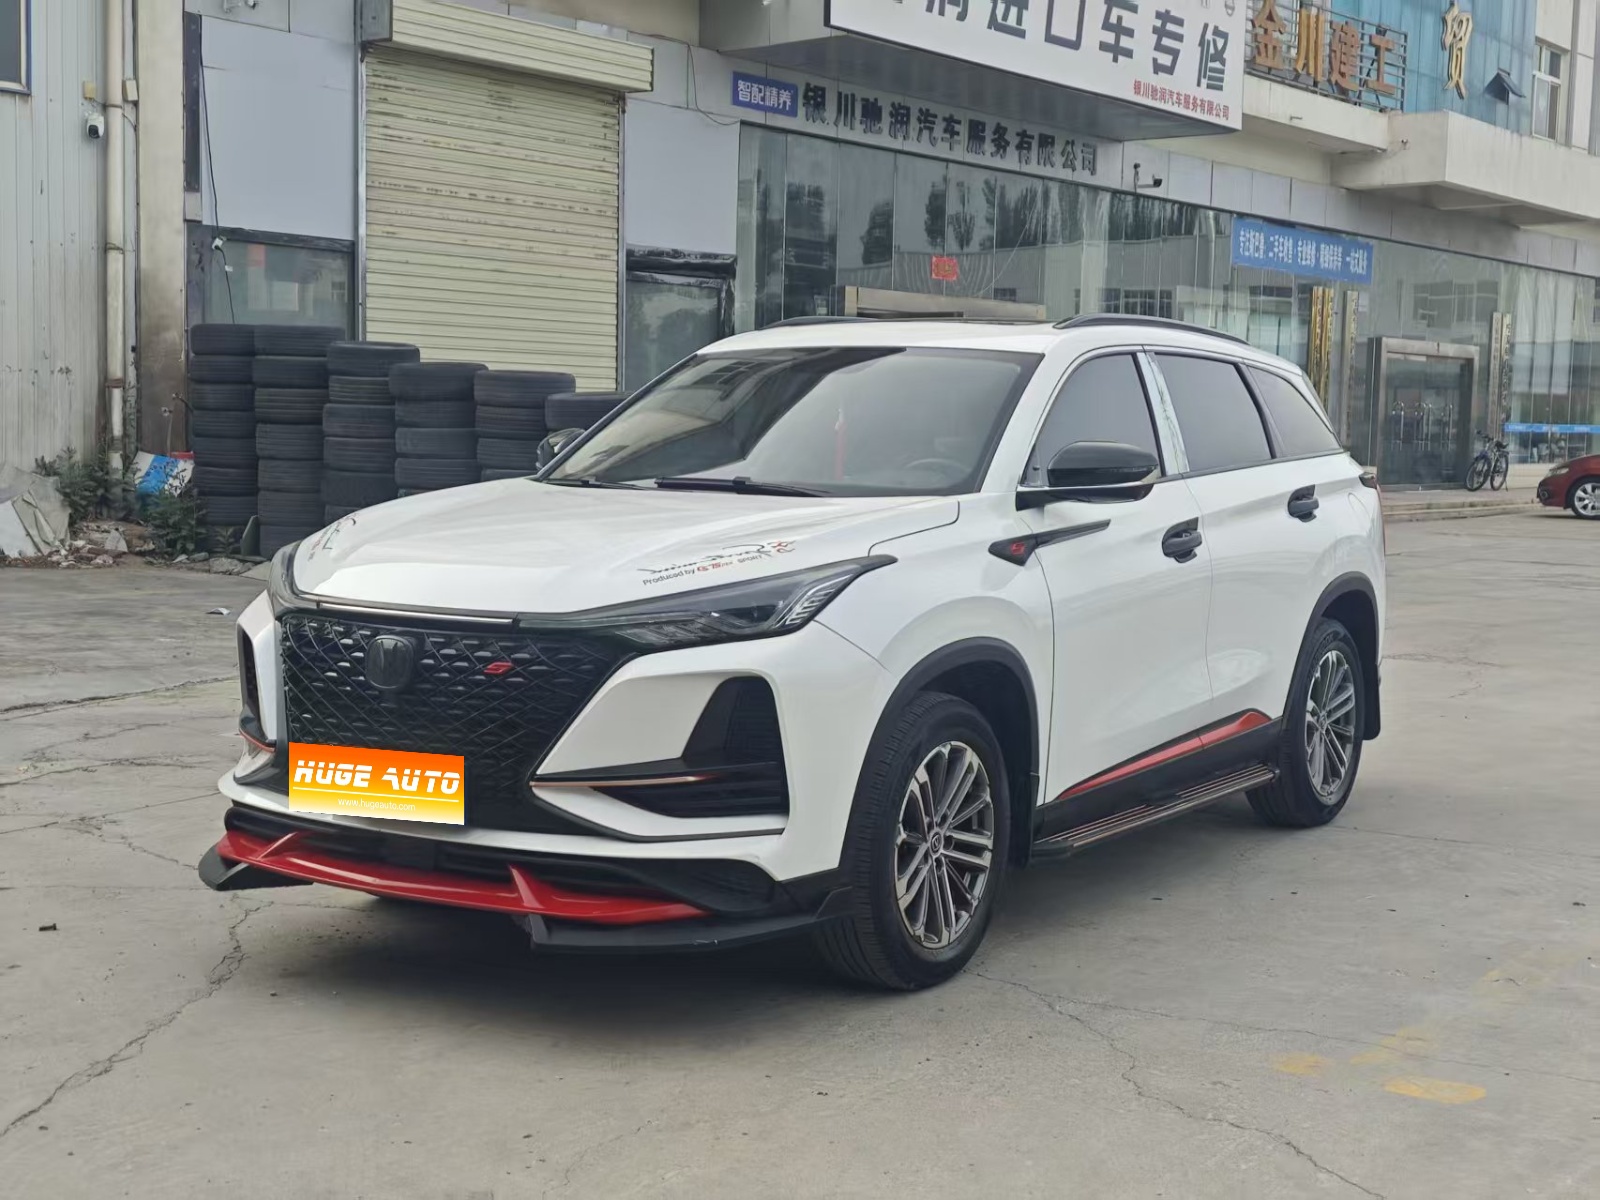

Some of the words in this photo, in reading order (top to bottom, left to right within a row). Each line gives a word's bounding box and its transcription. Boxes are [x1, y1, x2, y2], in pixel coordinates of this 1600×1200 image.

[737, 78, 793, 113] 智配精养
[1133, 78, 1230, 121] 银川驰润汽车服务有限公司
[801, 80, 1099, 177] 银川驰润汽车服务有限公司
[642, 567, 684, 586] Produced
[684, 566, 696, 576] by
